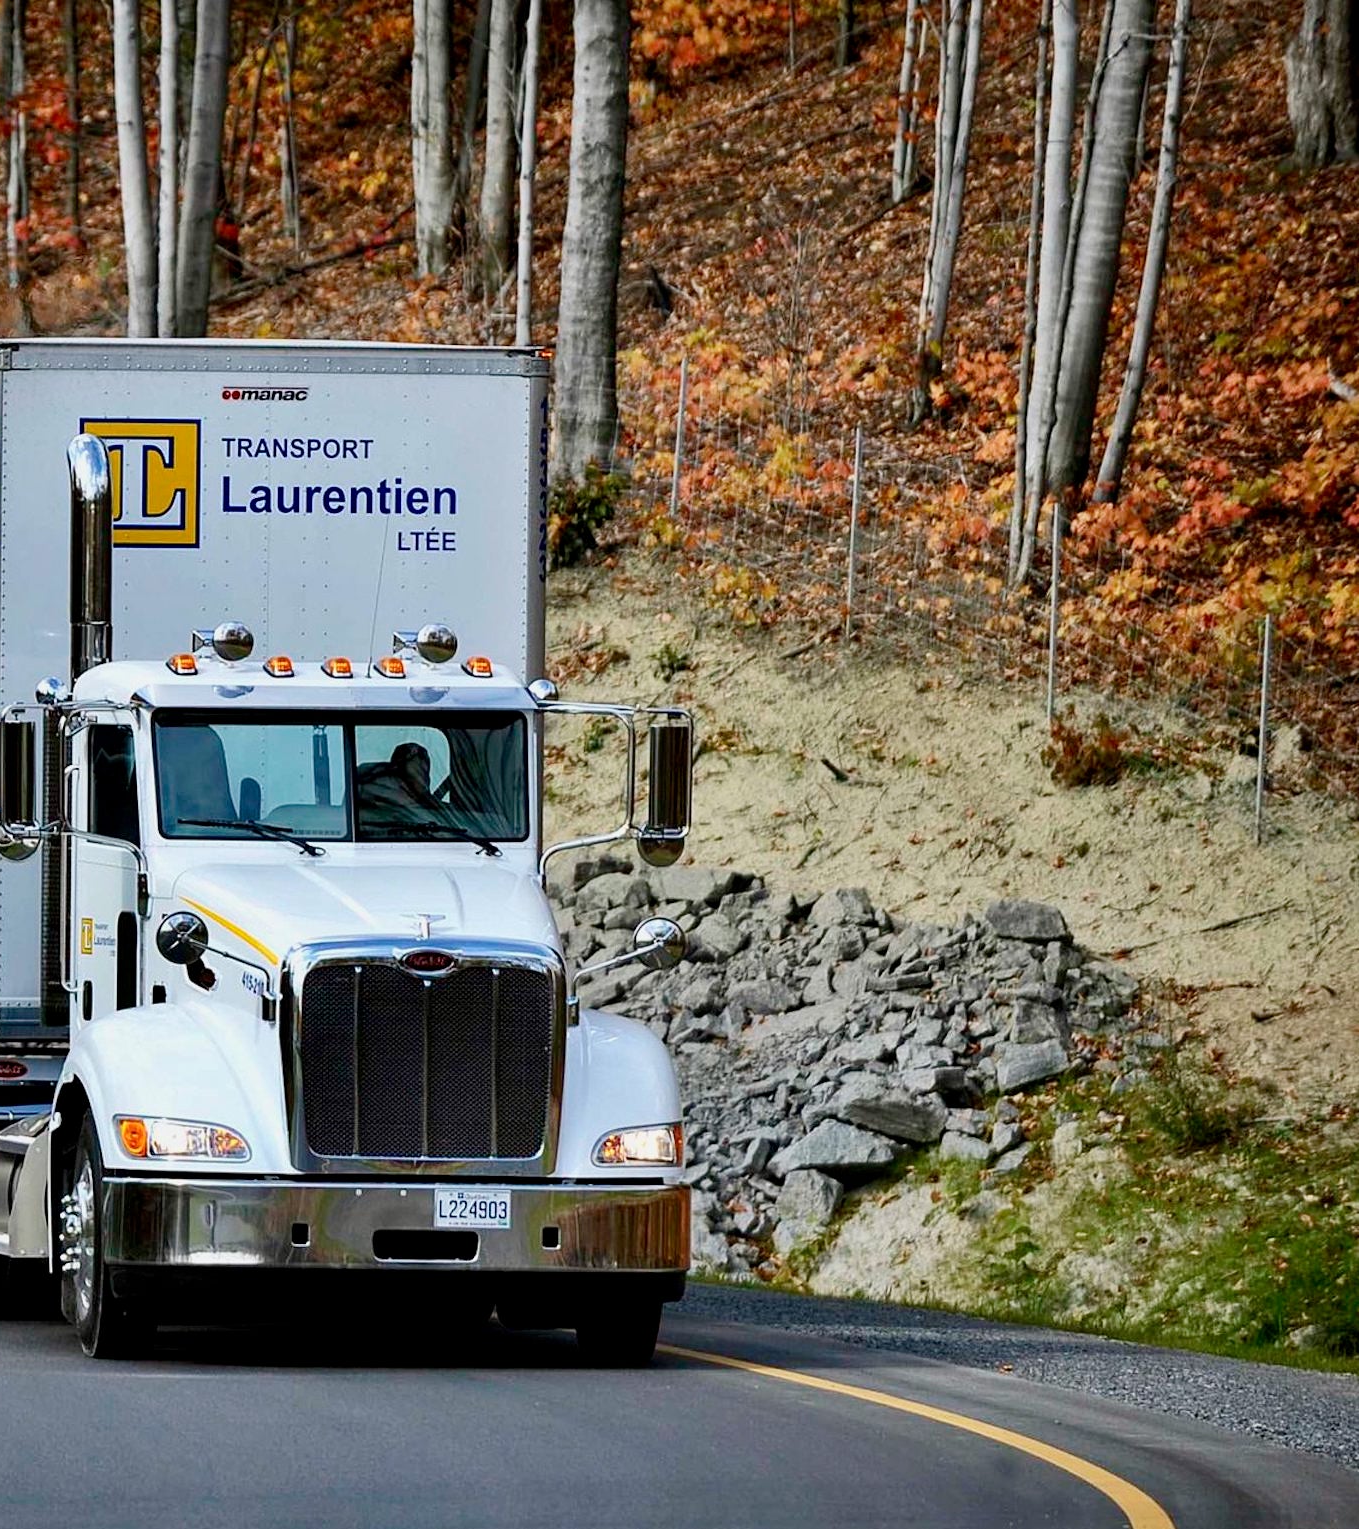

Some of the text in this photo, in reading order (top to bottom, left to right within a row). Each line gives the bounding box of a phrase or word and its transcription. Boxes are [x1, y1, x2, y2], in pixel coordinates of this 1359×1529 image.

[222, 438, 373, 458] TRANSPORT
[223, 476, 456, 514] Laurentien
[398, 527, 456, 551] LTÉE
[440, 1200, 507, 1219] L224903
